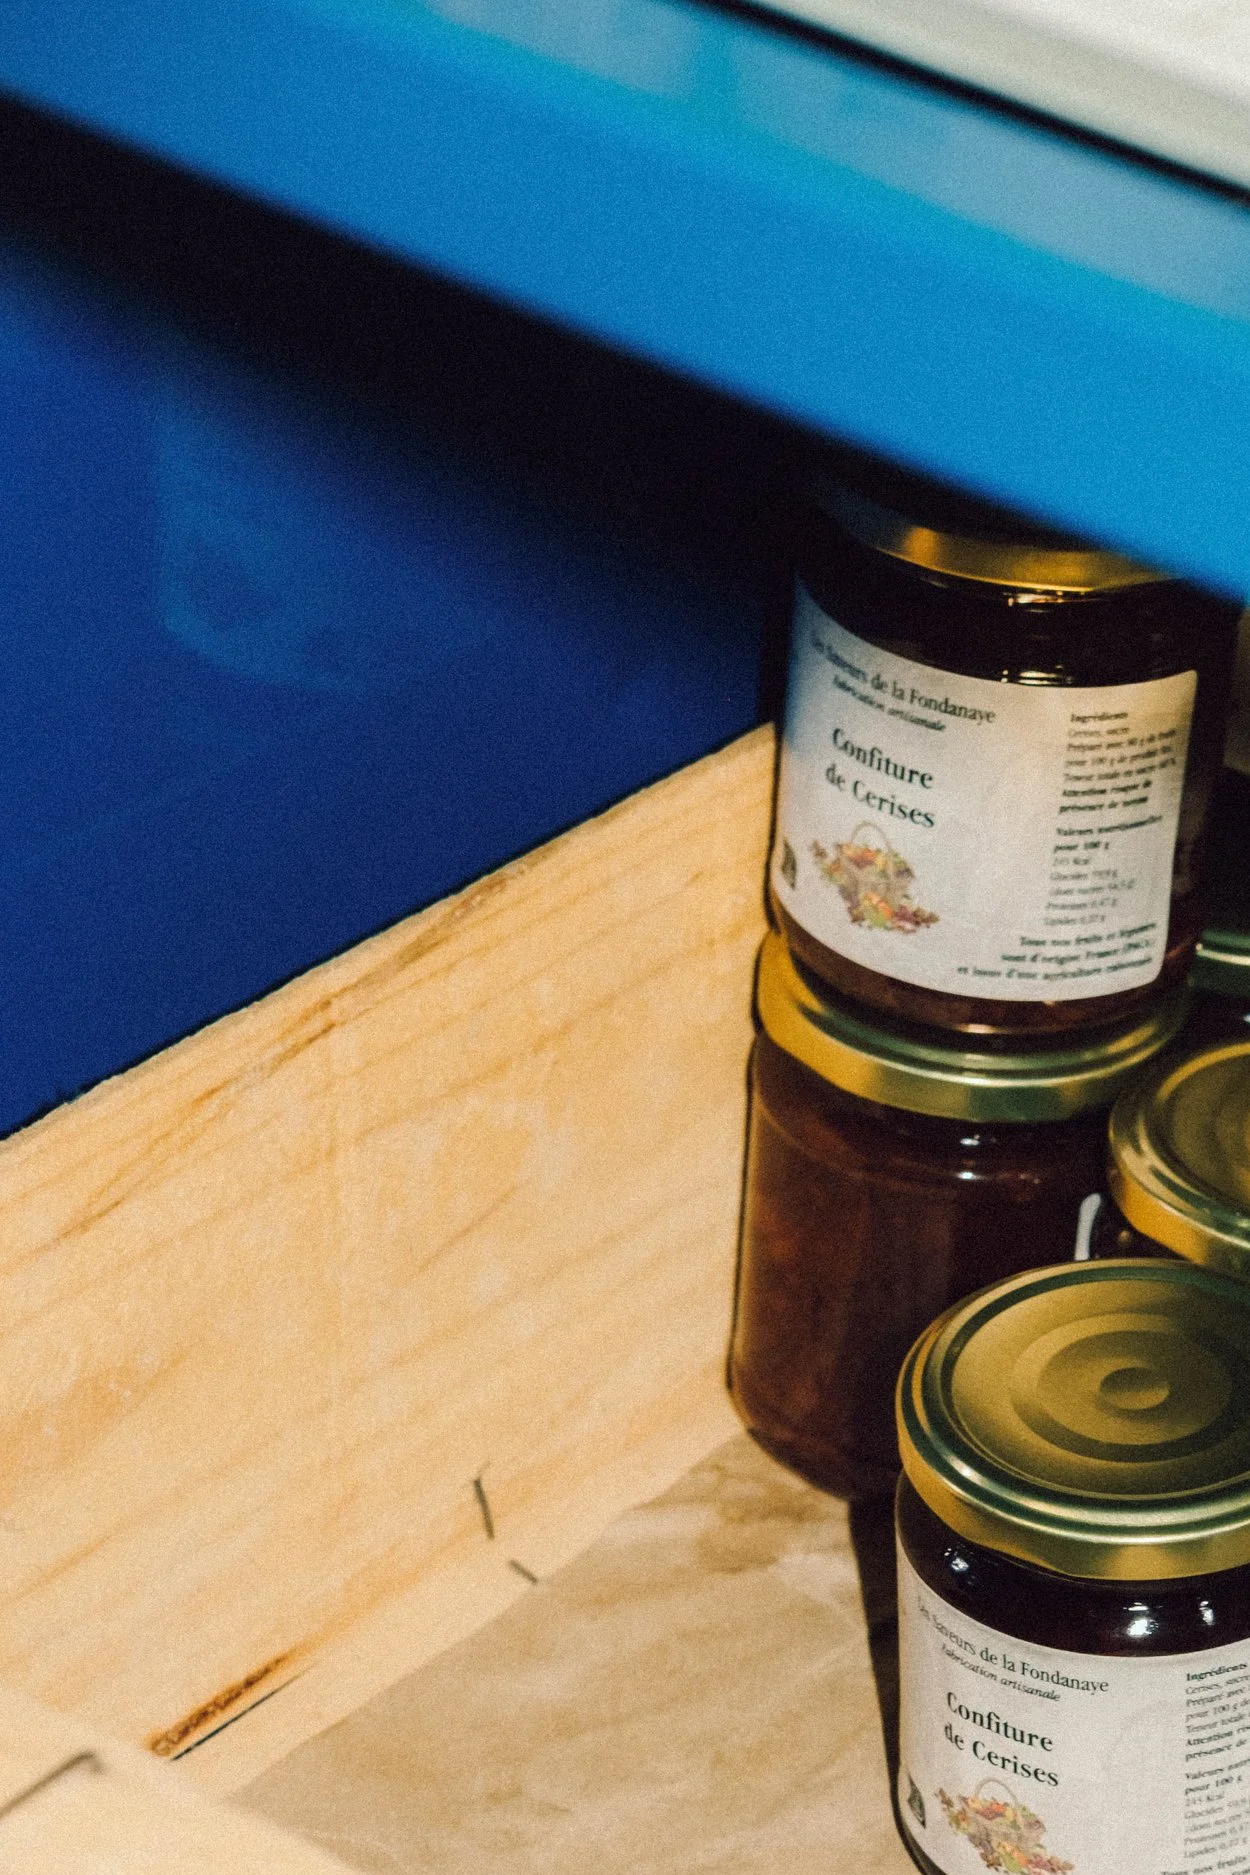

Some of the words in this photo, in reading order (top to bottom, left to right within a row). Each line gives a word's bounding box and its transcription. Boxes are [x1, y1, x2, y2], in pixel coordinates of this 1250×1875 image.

[892, 680, 905, 701] la
[910, 688, 996, 726] Fondanaye
[832, 728, 934, 790] Confiture
[825, 761, 847, 791] de
[853, 779, 936, 829] Cerises
[980, 1647, 998, 1665] de
[1002, 1654, 1016, 1673] la
[1020, 1660, 1110, 1695] Fondanaye
[1000, 1676, 1061, 1702] artisanale
[946, 1691, 1054, 1753] Confiture
[943, 1722, 965, 1752] de
[971, 1739, 1060, 1788] Cerises
